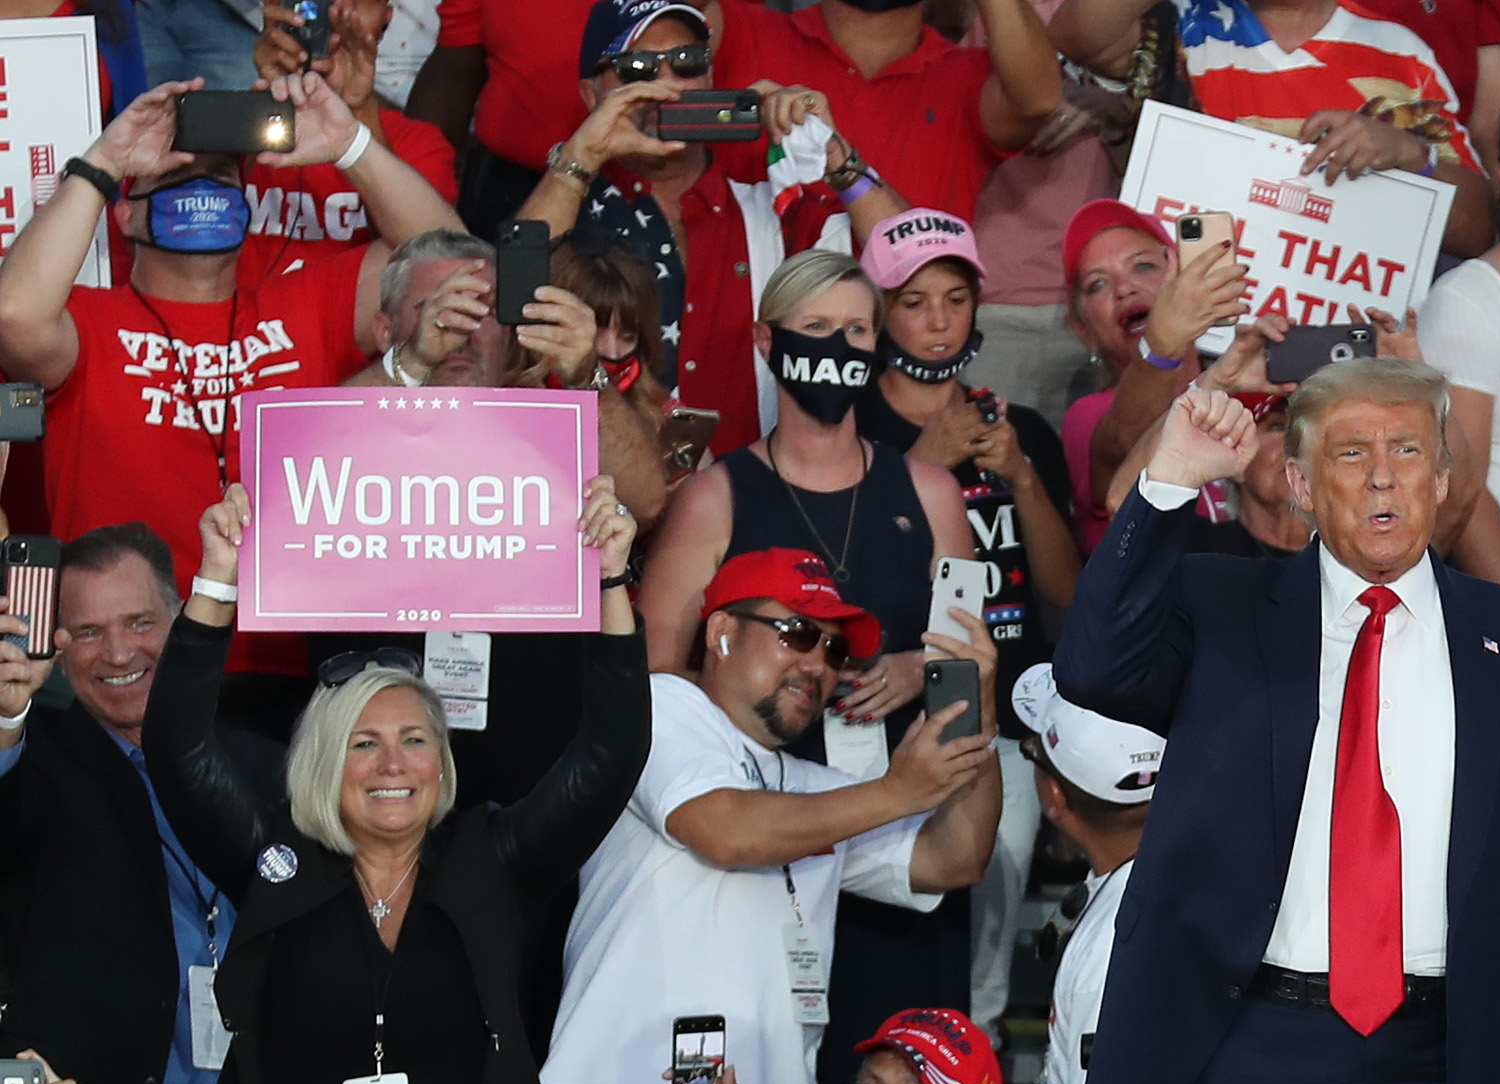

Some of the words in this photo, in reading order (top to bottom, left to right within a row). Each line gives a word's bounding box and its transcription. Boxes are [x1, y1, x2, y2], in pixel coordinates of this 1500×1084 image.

[174, 196, 230, 213] TRUMP
[245, 183, 368, 241] MAG
[883, 216, 966, 245] TRUMP
[1278, 229, 1406, 297] THAT
[118, 319, 294, 377] VETERAN
[782, 353, 871, 387] MAG
[192, 376, 236, 396] FOR
[283, 457, 550, 526] Women
[314, 534, 388, 559] FOR
[400, 535, 527, 560] TRUMP
[396, 609, 442, 622] 2020
